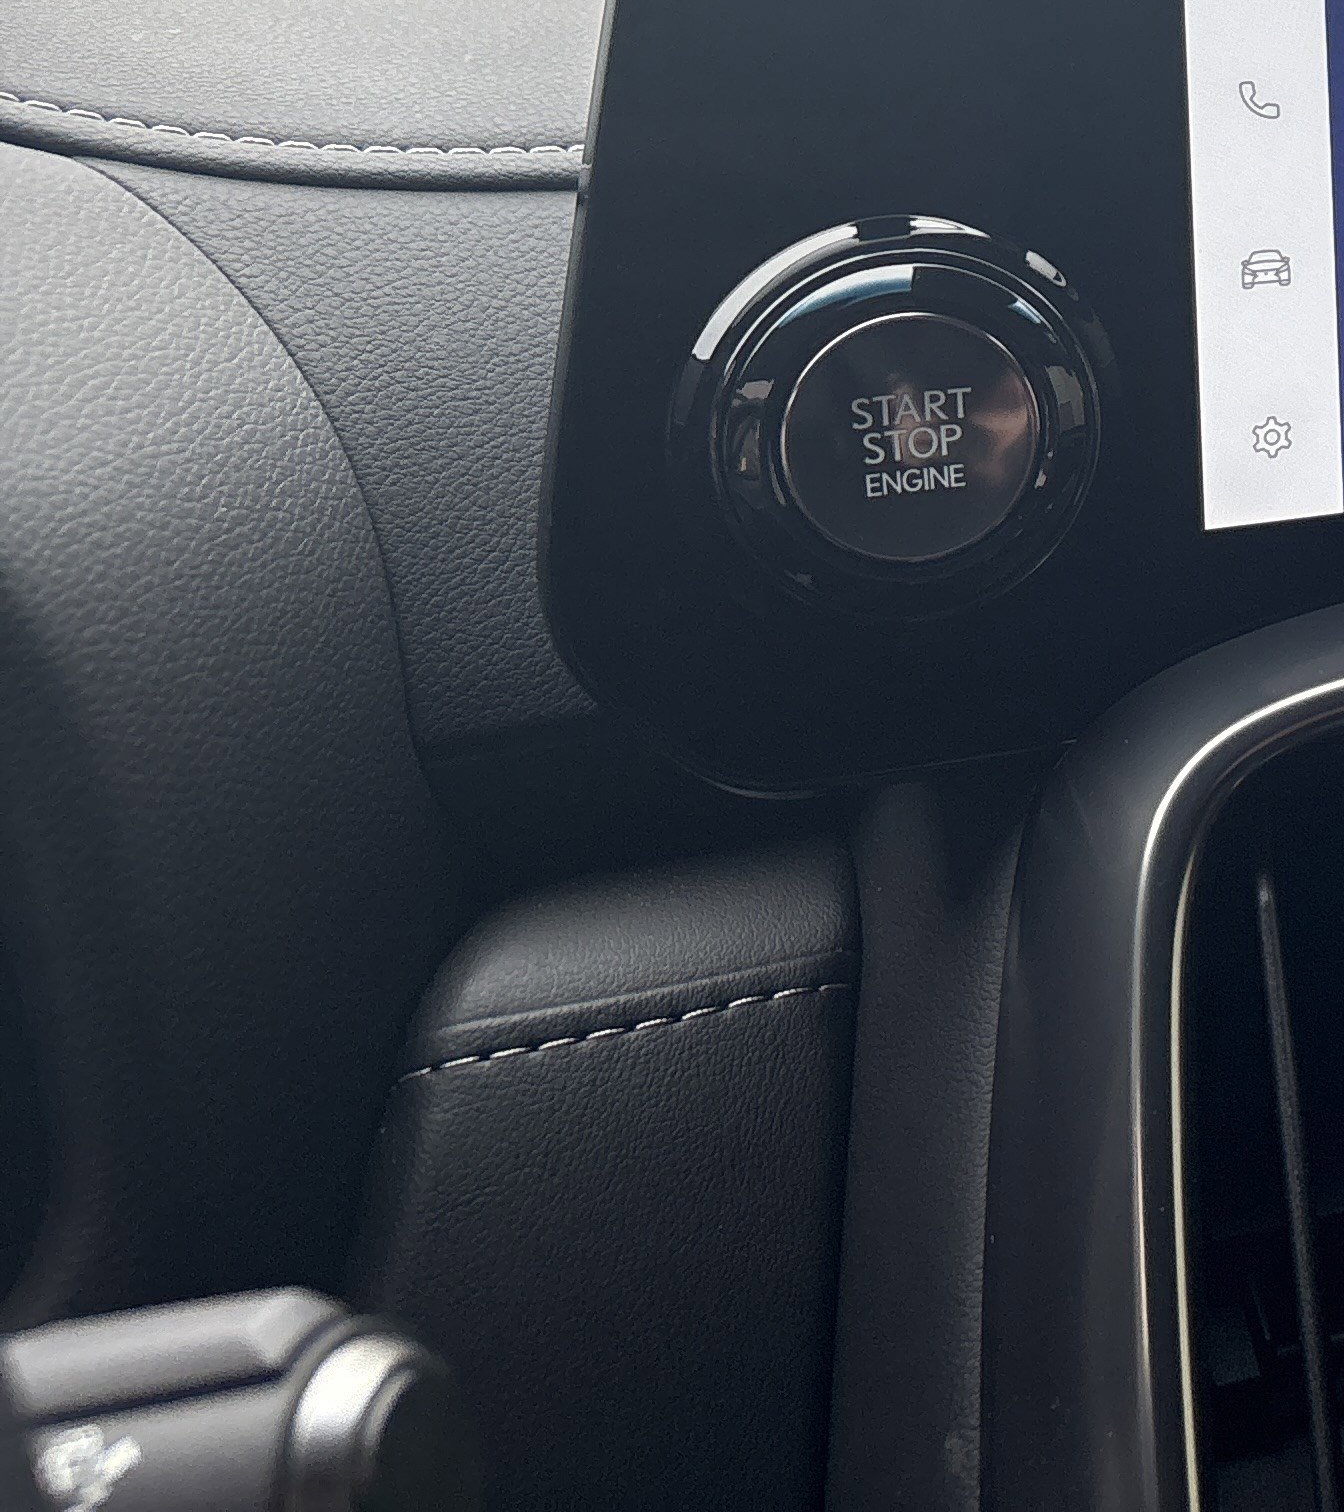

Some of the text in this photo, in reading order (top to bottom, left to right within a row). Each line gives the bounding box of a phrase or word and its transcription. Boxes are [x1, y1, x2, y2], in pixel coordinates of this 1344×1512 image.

[851, 388, 971, 430] START
[863, 424, 962, 464] STOP
[865, 464, 966, 497] ENGINE
